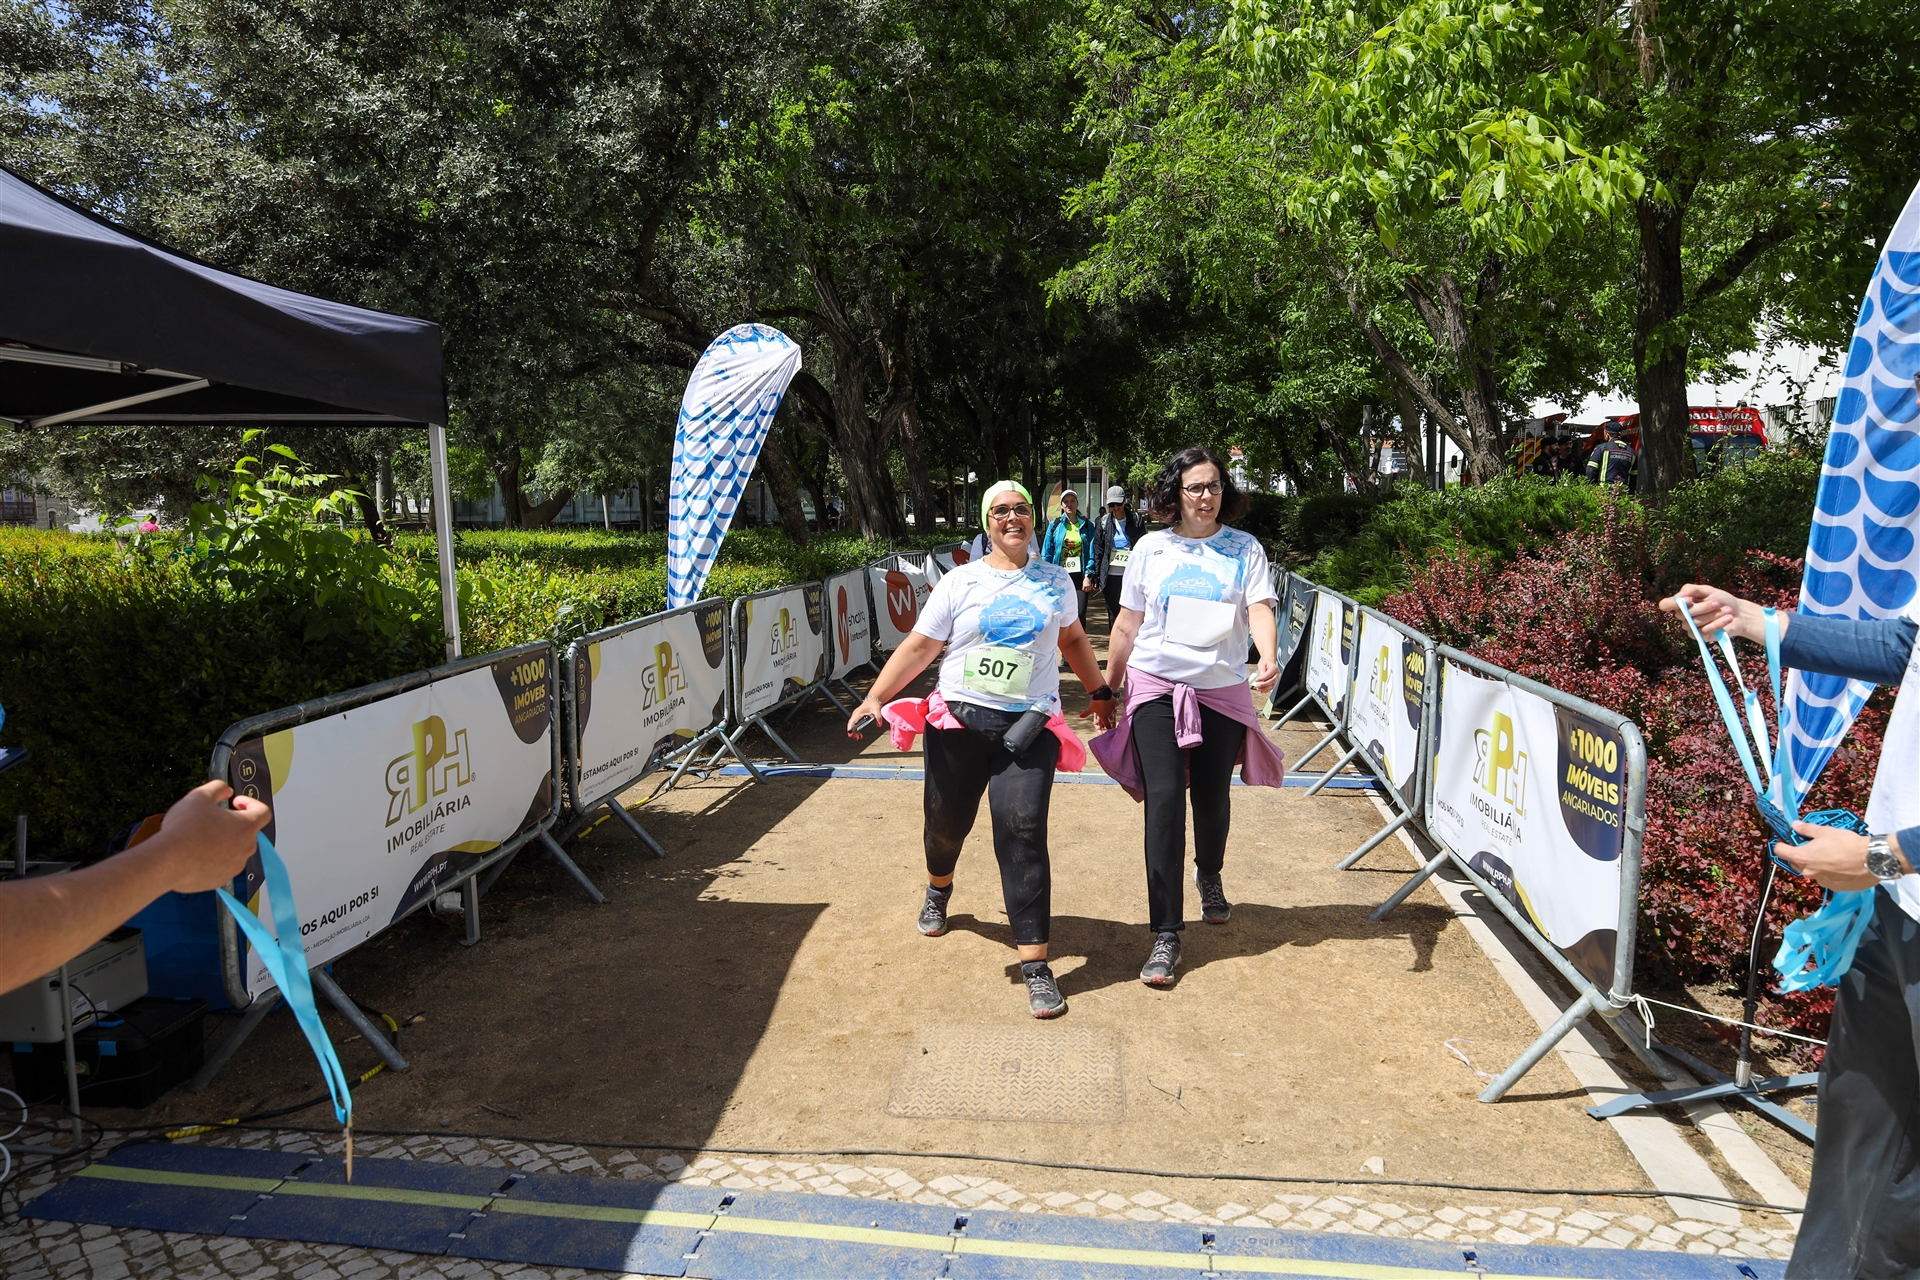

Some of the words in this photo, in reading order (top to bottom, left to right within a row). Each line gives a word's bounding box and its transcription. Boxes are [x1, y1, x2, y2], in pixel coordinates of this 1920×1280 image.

[1689, 410, 1752, 420] BULÂNCIA
[1690, 423, 1753, 432] ERGÊNCIA
[705, 609, 722, 628] +1000
[510, 658, 545, 687] +1000
[978, 657, 1018, 680] 507
[514, 684, 545, 710] IMÓVEIS
[514, 702, 546, 725] ANGARIADOS
[583, 762, 609, 780] ESTAMOS
[609, 755, 622, 768] AQUI
[623, 750, 633, 761] POR
[634, 747, 639, 756] SI
[1570, 728, 1618, 773] +1000
[1566, 763, 1619, 806] IMÓVEIS
[1562, 790, 1619, 828] ANGARIADOS
[387, 795, 471, 854] IMOBILIÁRIA
[1481, 819, 1491, 835] REAL
[1491, 826, 1513, 846] ESTATE
[410, 838, 424, 855] REAL
[424, 824, 446, 844] ESTATE
[320, 904, 347, 927] AQUI
[349, 892, 369, 912] POR
[370, 886, 379, 900] SI
